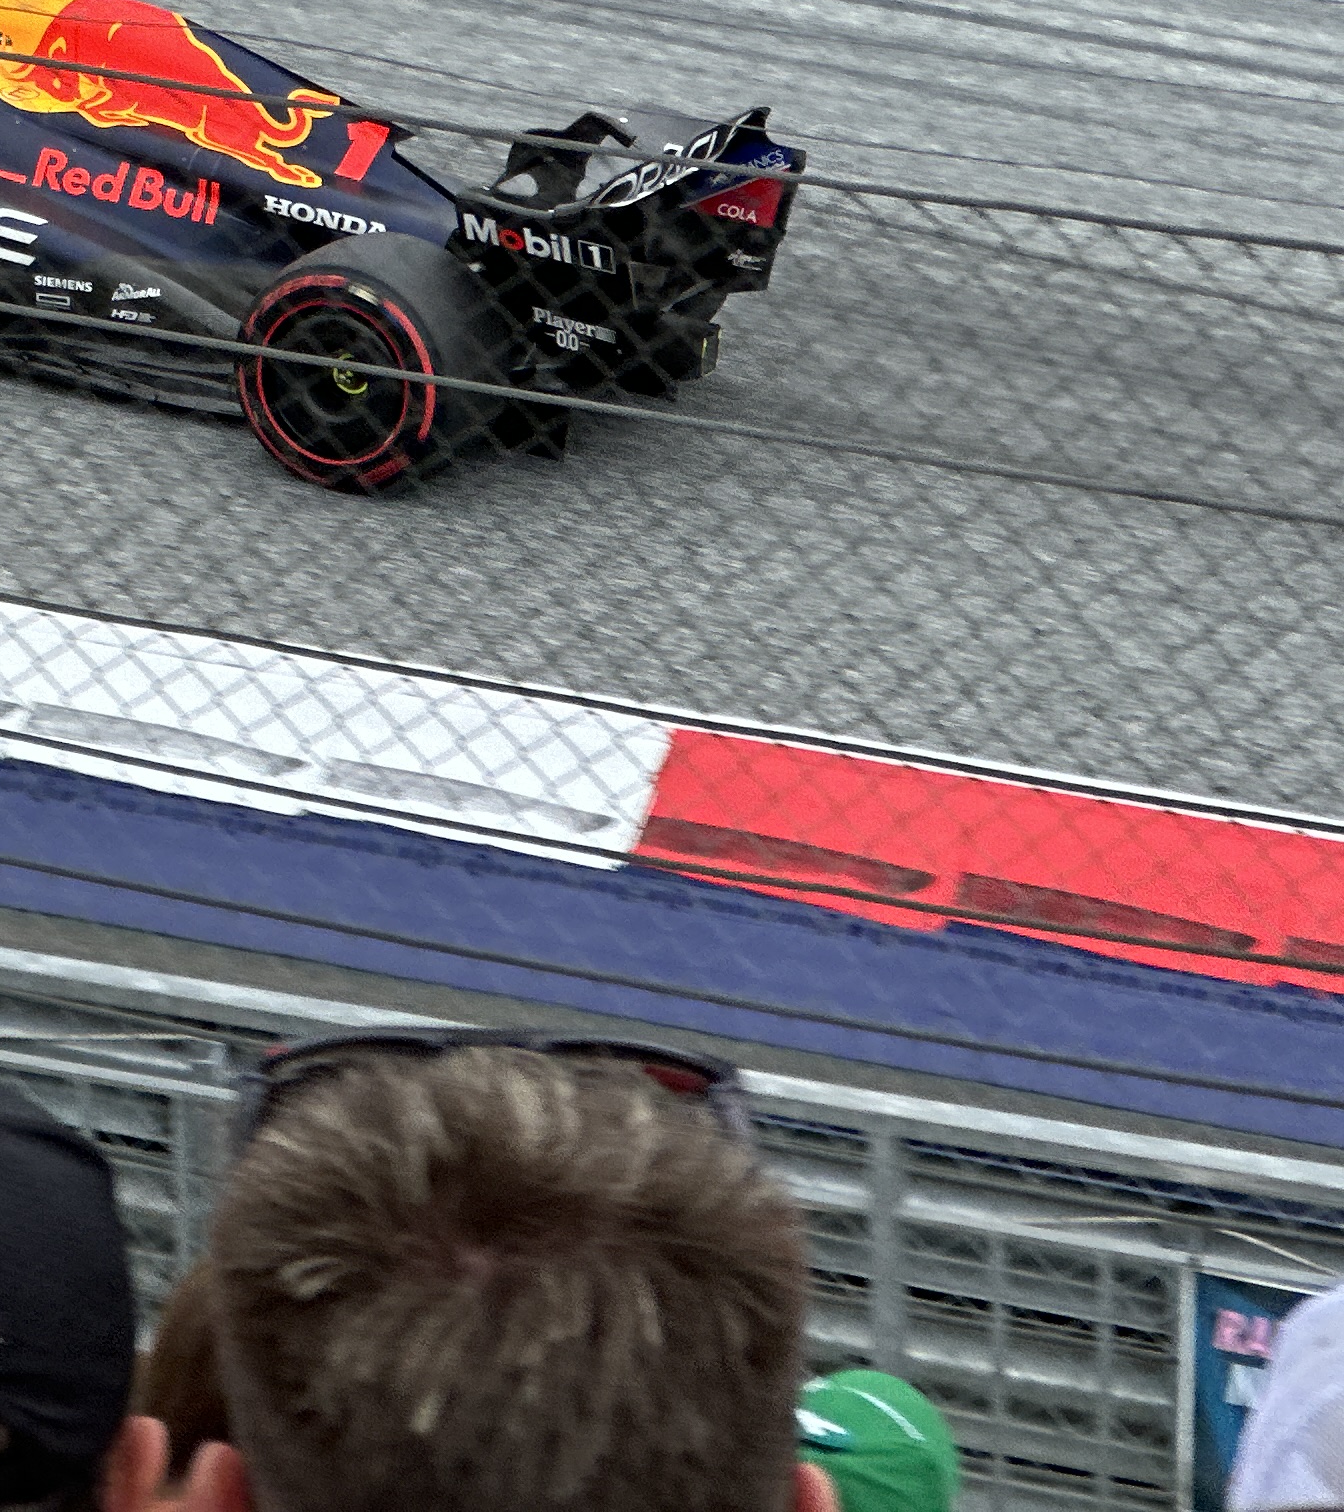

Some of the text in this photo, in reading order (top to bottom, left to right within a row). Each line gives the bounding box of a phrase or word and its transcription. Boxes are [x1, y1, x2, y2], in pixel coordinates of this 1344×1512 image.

[333, 120, 391, 183] 1
[31, 146, 221, 226] Red Bull
[463, 213, 573, 264] Mobil
[716, 202, 758, 224] COLA
[34, 274, 93, 293] SIEMENS
